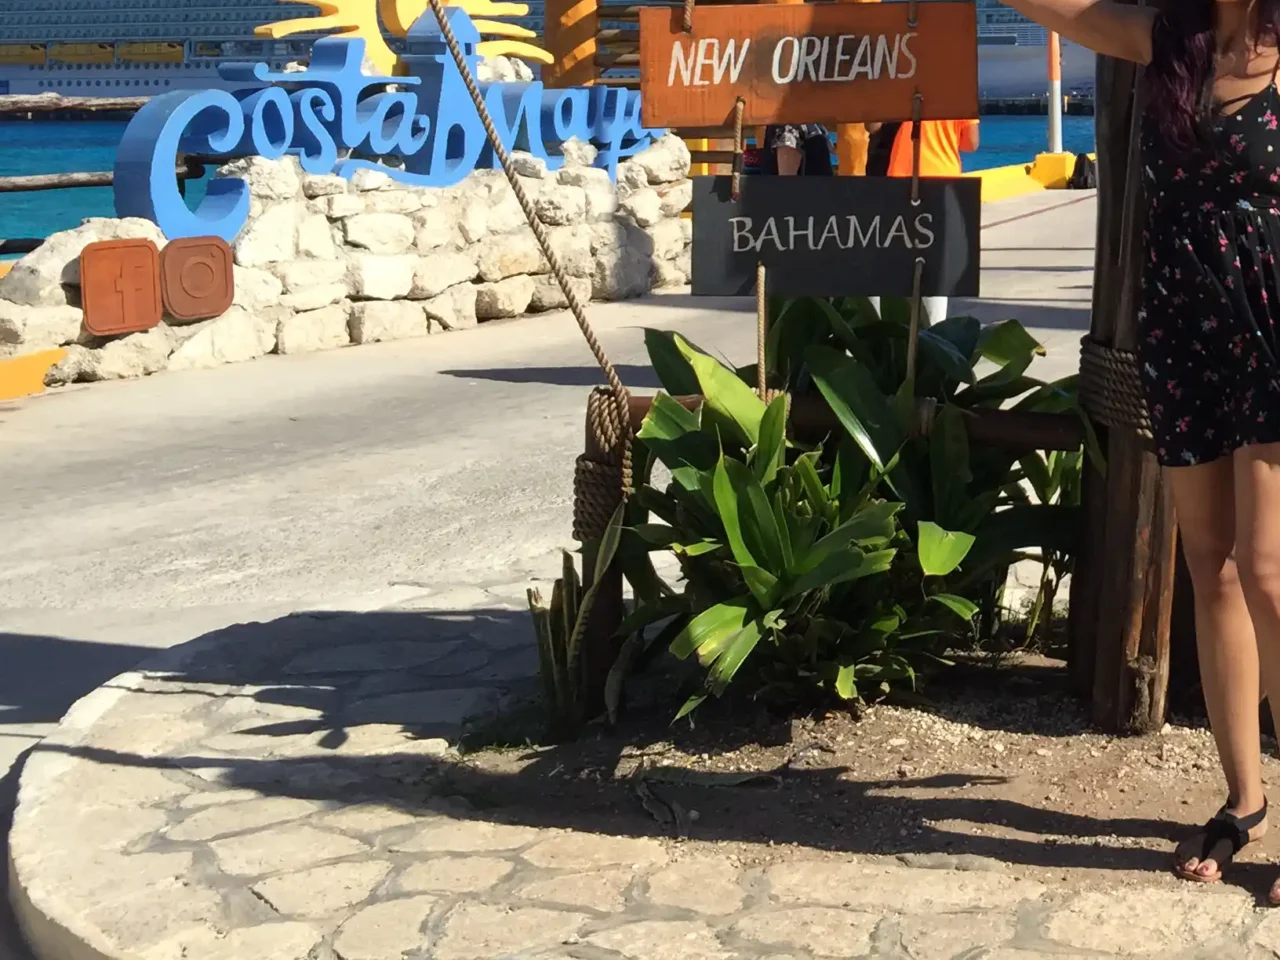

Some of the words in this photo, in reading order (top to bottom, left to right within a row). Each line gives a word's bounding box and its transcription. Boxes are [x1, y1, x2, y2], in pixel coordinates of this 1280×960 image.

[667, 37, 751, 87] NEW
[771, 31, 919, 86] ORLEANS
[729, 212, 936, 254] BAHAMAS
